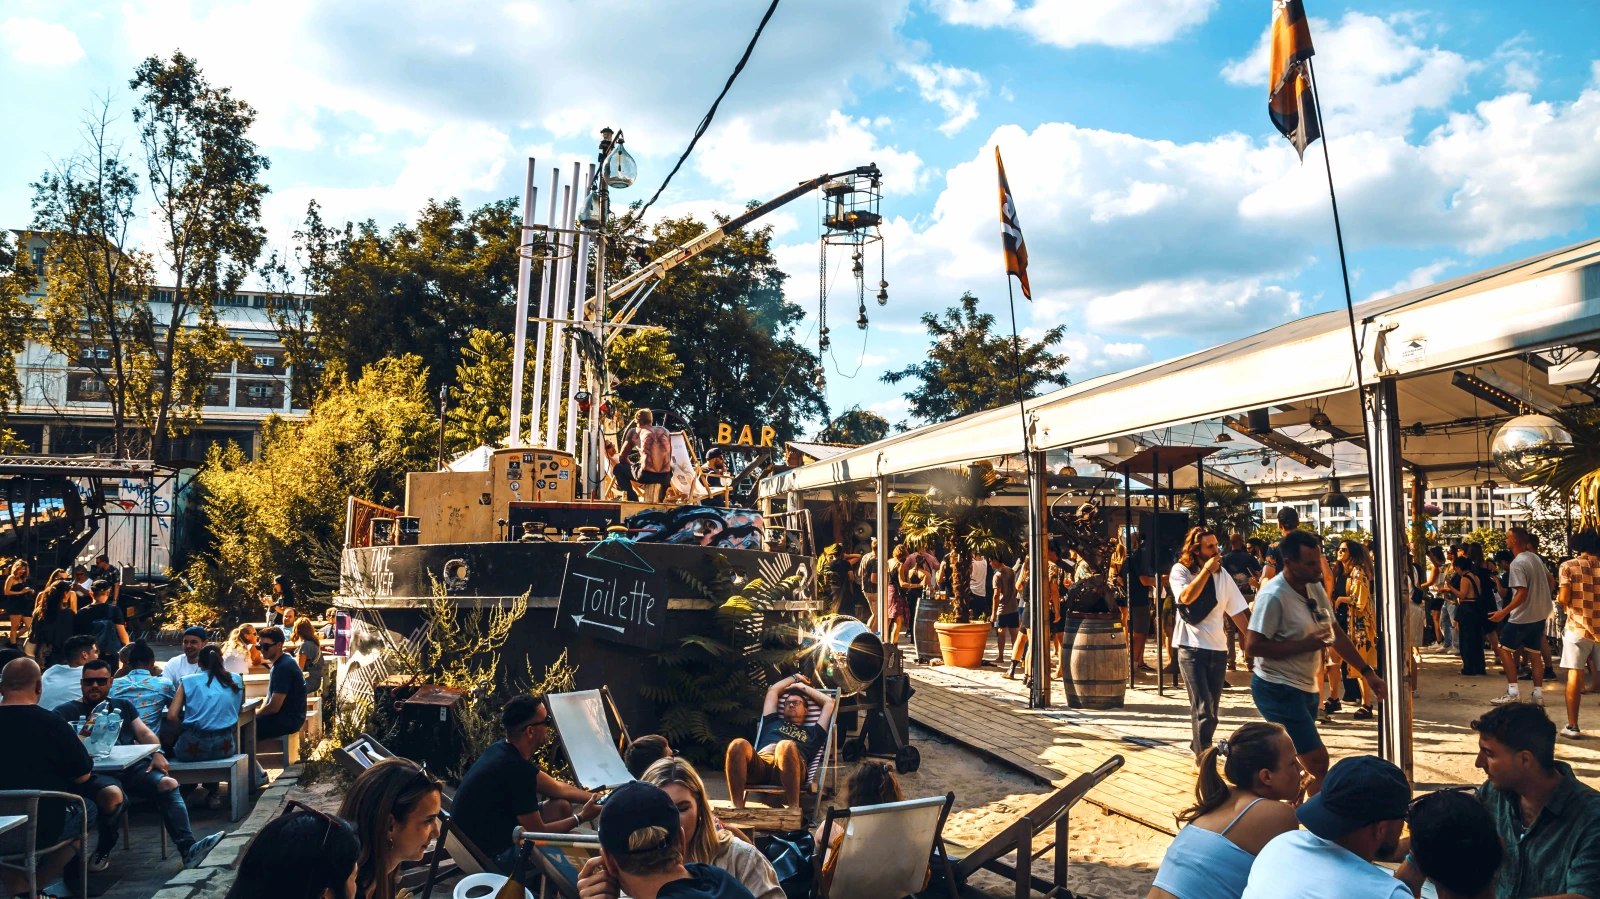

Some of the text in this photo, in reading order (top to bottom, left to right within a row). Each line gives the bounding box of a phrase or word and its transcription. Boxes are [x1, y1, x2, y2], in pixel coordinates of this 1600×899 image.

[717, 423, 776, 447] BAR
[370, 547, 393, 572] TAPE
[572, 572, 655, 626] Toilette
